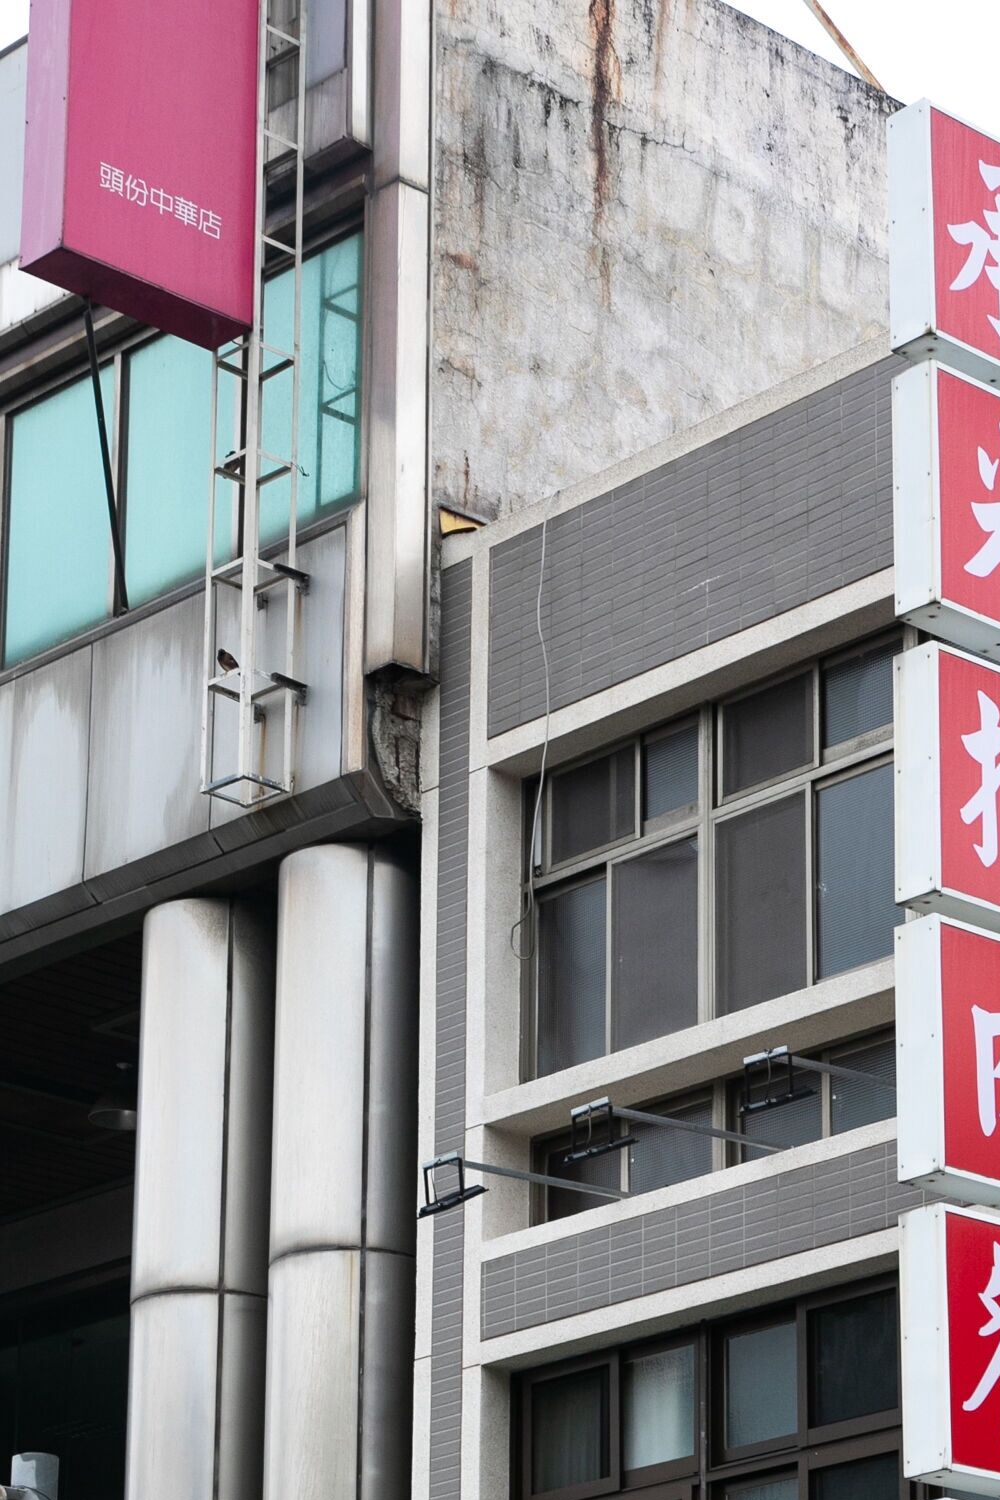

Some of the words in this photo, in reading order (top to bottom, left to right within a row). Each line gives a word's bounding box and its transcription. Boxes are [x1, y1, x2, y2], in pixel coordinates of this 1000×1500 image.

[99, 161, 222, 240] 頭份中華店
